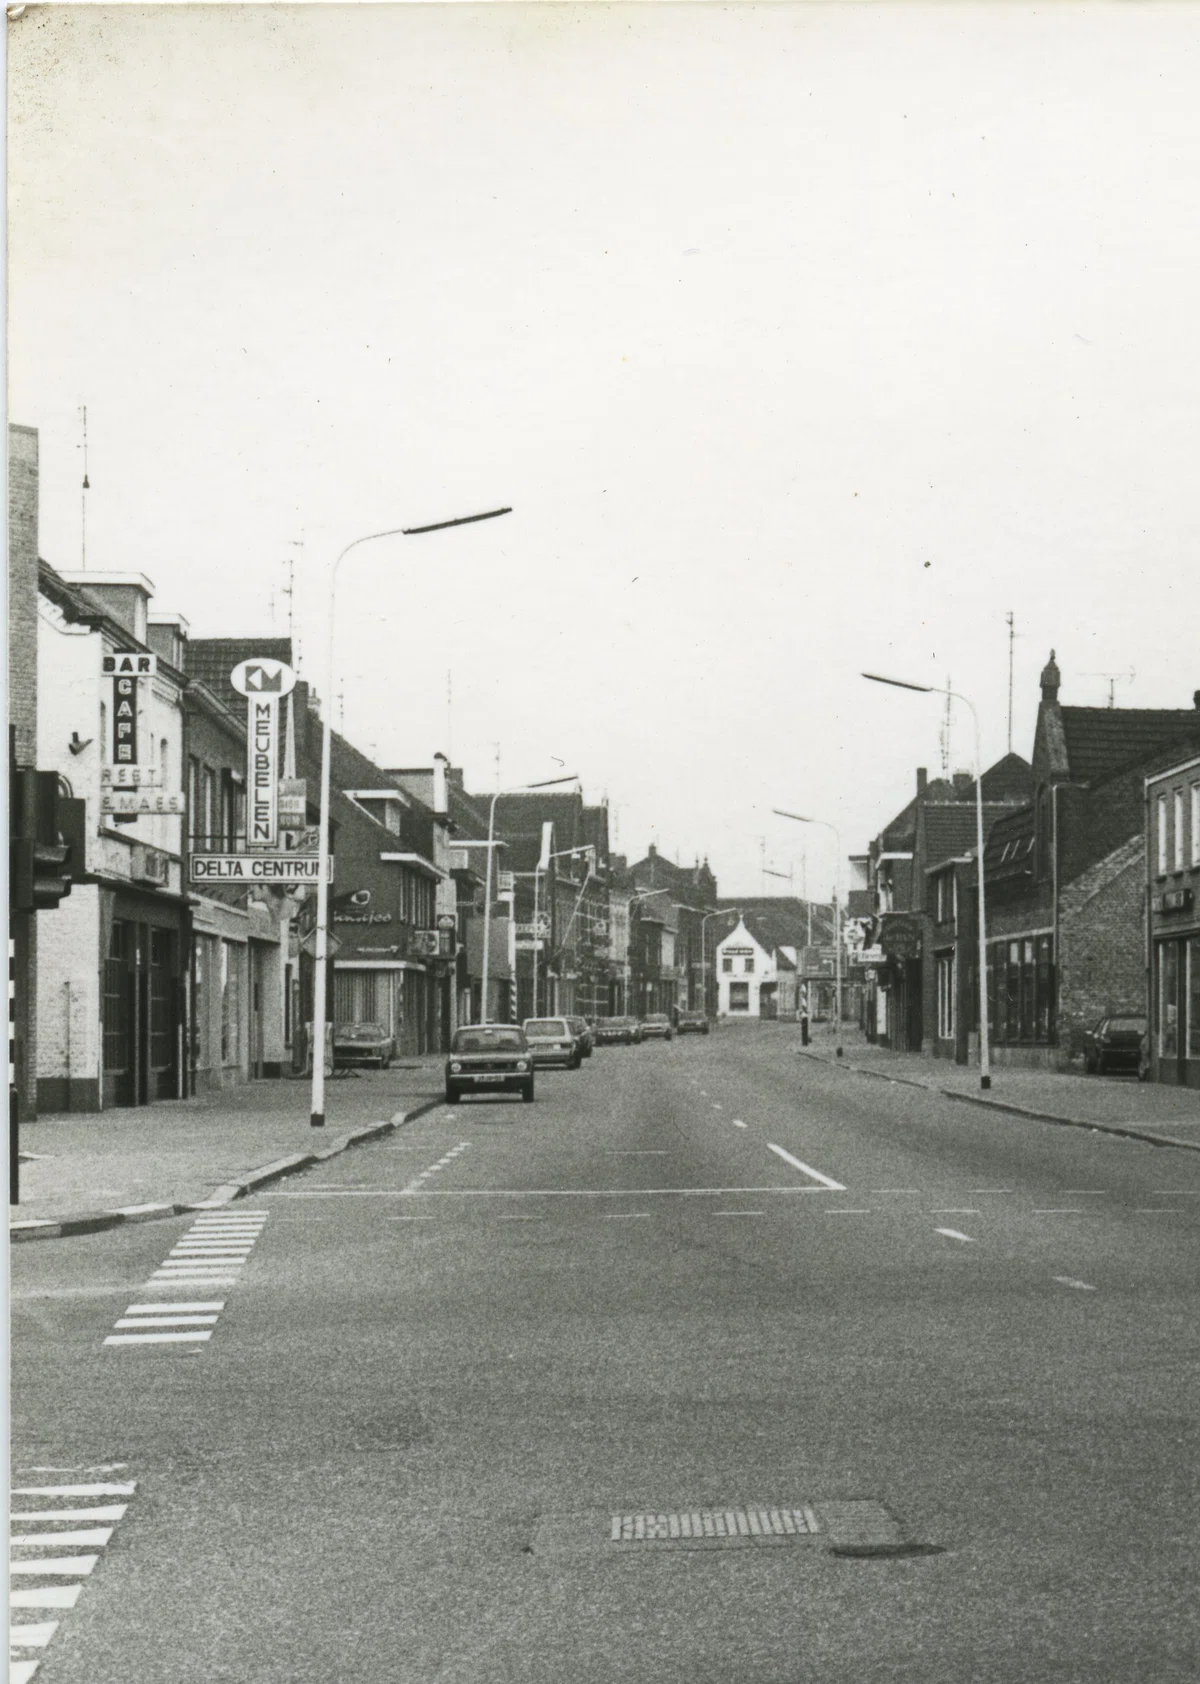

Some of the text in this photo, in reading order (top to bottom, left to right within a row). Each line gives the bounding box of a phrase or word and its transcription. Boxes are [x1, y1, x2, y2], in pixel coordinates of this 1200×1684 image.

[103, 657, 151, 672] BAR
[117, 679, 132, 760] CAFE
[253, 703, 271, 840] MEUBELEN
[195, 860, 243, 876] DELTA
